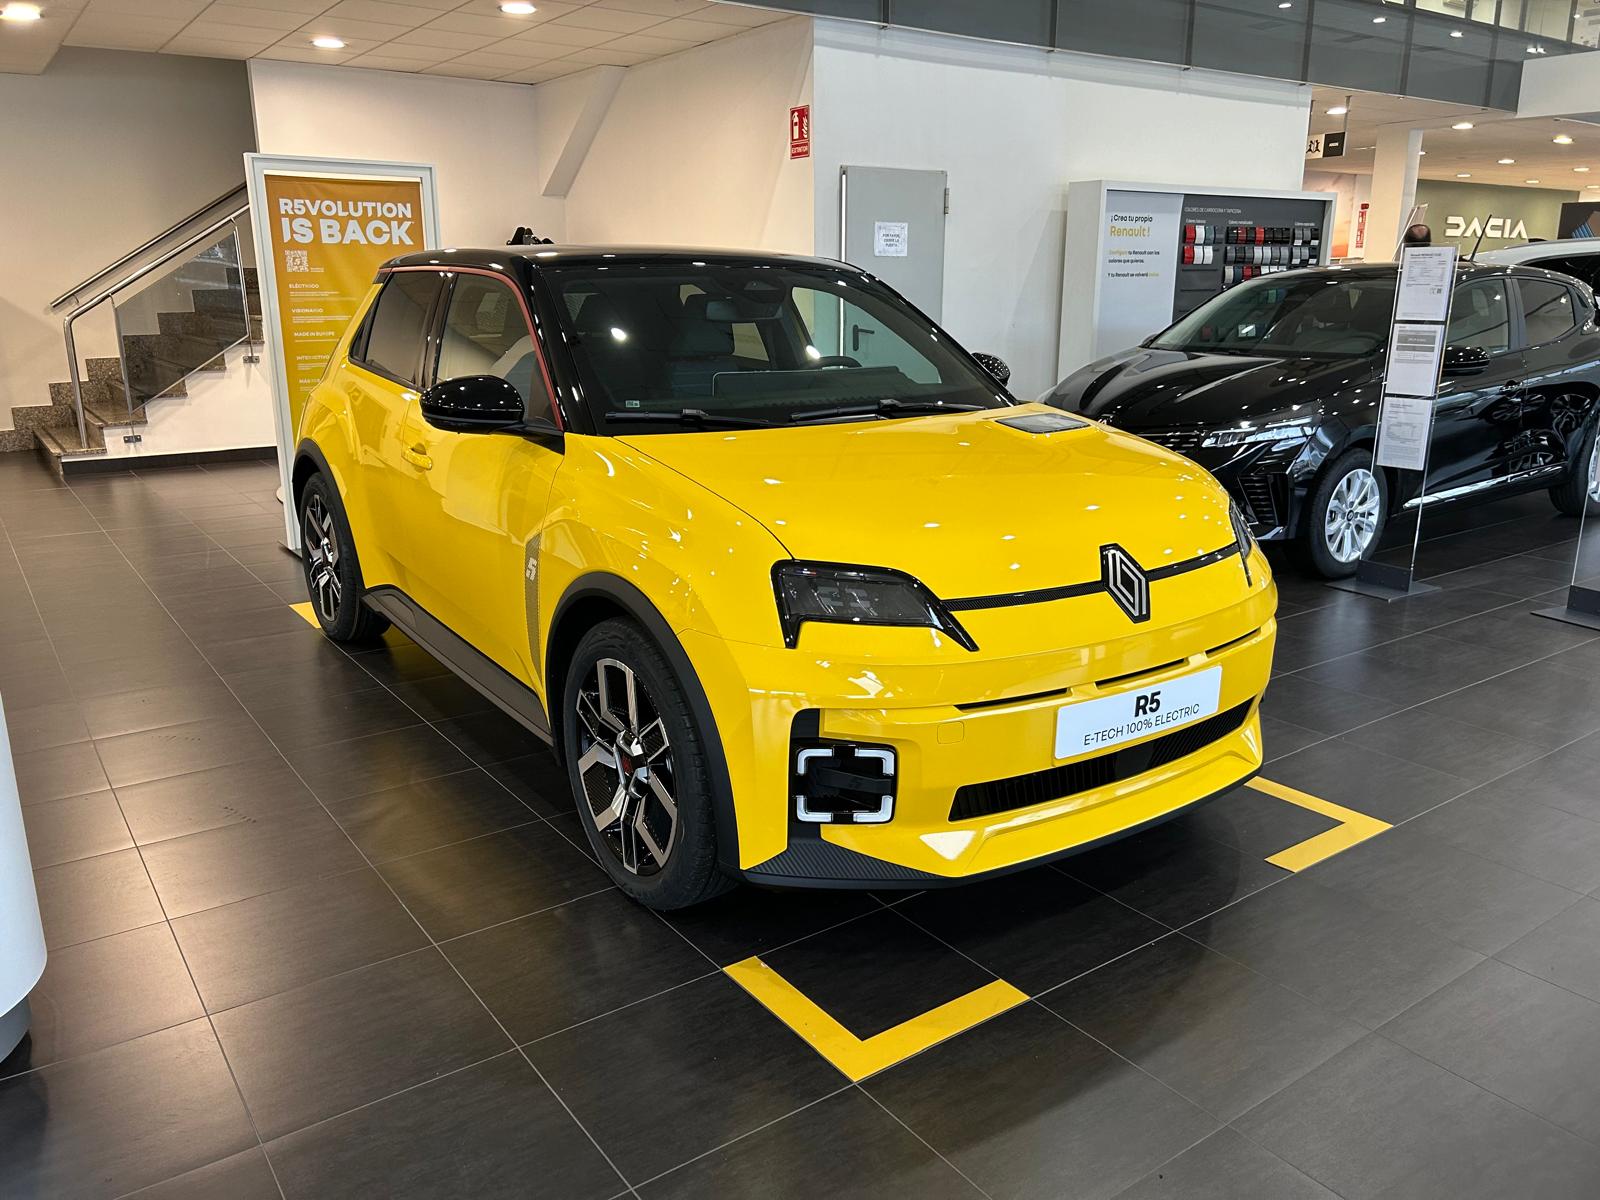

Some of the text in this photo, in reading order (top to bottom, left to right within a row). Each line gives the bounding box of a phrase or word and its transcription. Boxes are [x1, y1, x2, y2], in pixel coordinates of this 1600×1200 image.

[279, 198, 412, 218] R5VOLUTION
[1135, 215, 1153, 223] propio
[281, 218, 414, 246] IS BACK
[1445, 216, 1528, 239] DACIA
[1134, 690, 1162, 717] R5
[1083, 703, 1200, 746] E-TECH 100% ELECTRIC
